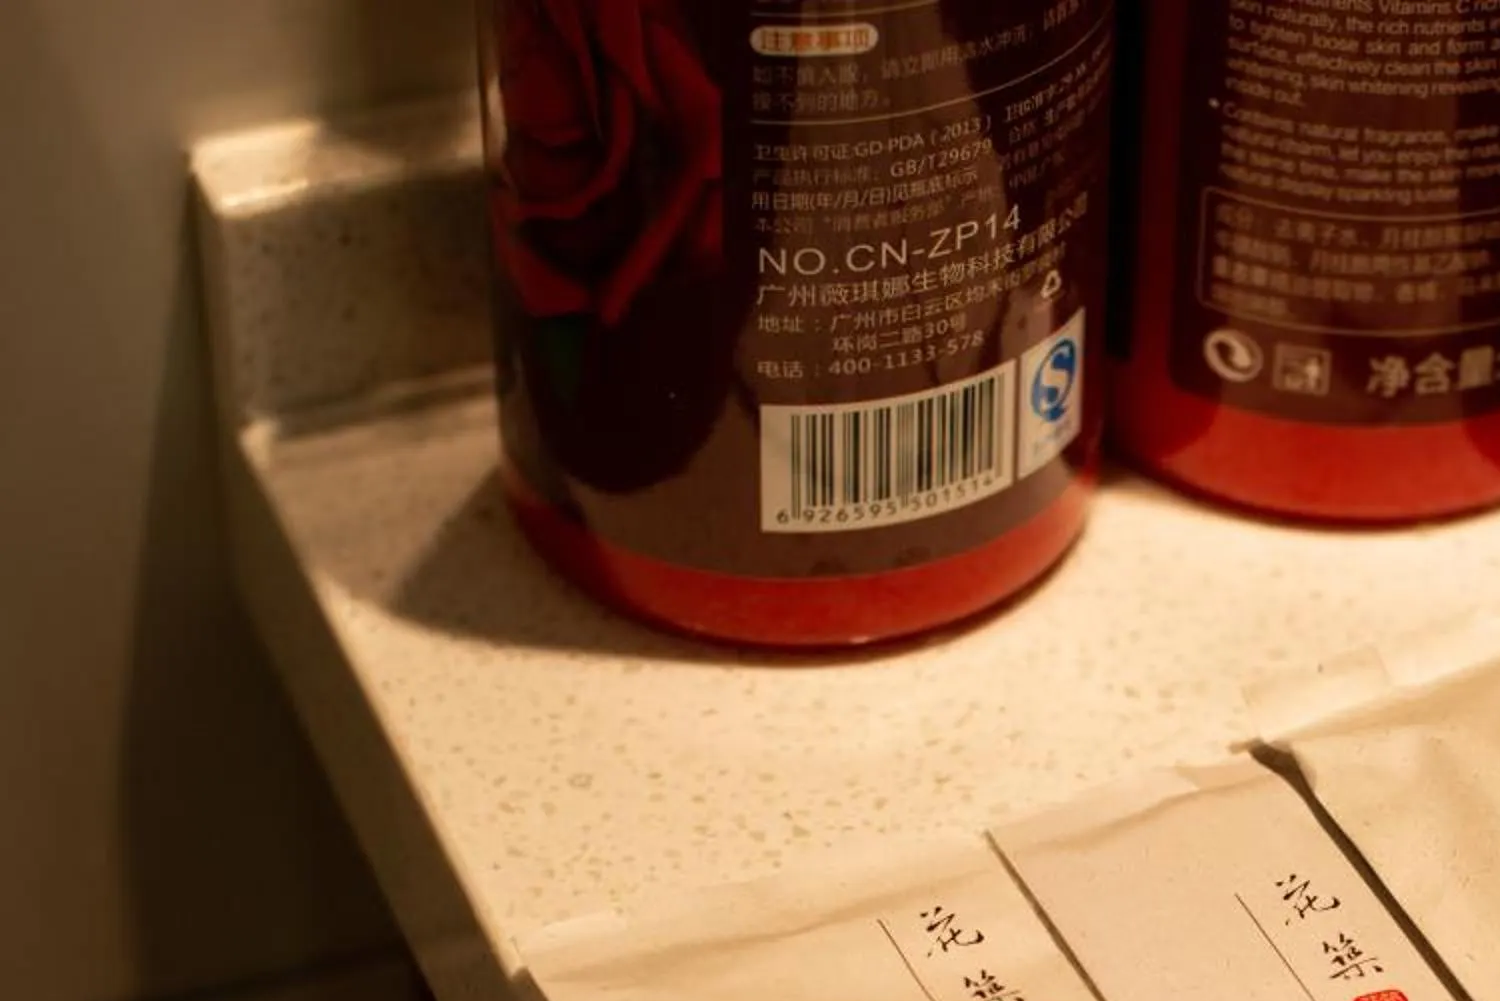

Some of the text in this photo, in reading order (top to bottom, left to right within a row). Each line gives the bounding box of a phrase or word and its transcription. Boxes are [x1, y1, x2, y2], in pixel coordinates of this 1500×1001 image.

[1228, 13, 1245, 30] to
[1312, 31, 1359, 53] loose
[1365, 39, 1401, 55] skin
[1408, 41, 1440, 56] and
[1447, 38, 1486, 54] form
[1346, 16, 1374, 33] the
[1377, 17, 1410, 34] rich
[1413, 18, 1485, 35] nutrients
[1465, 57, 1497, 75] skin
[1309, 74, 1345, 91] skin
[758, 203, 1021, 276] NO.CN-ZP14
[827, 329, 984, 376] 400-1133-578
